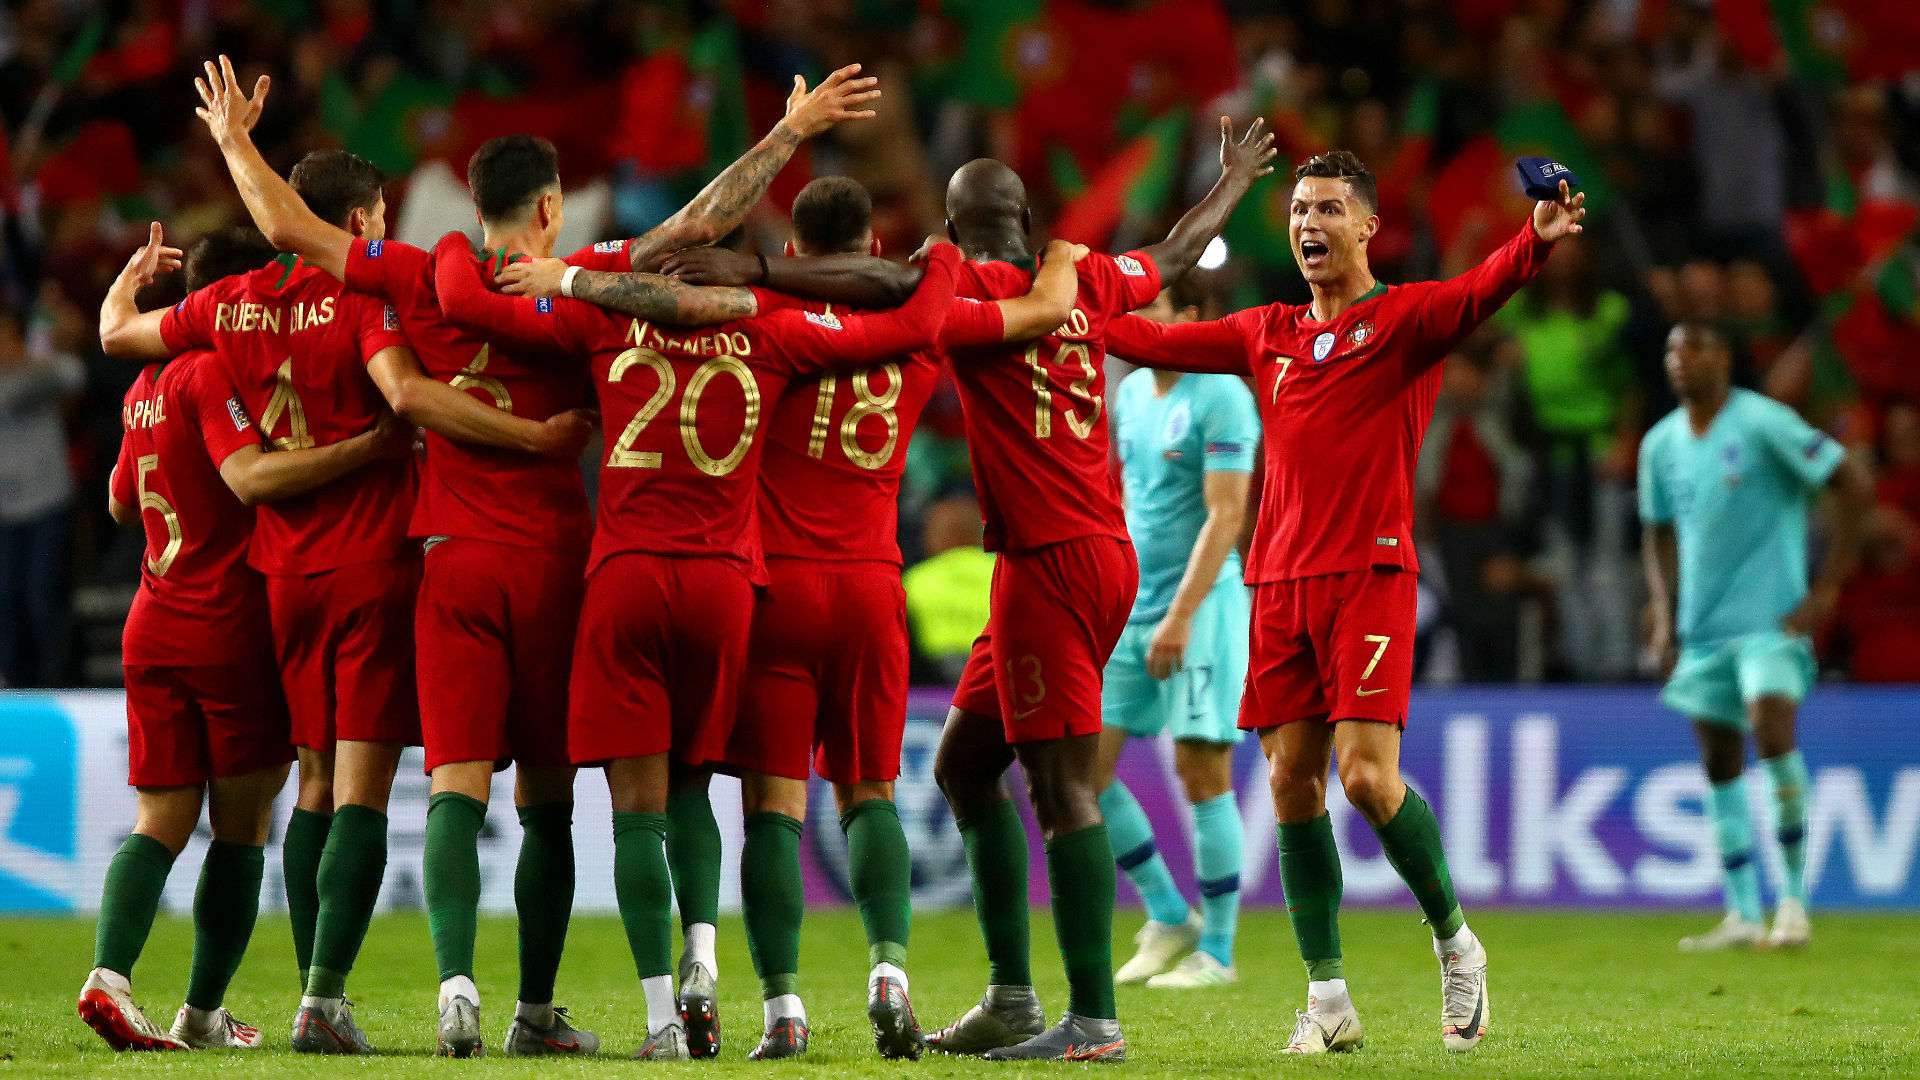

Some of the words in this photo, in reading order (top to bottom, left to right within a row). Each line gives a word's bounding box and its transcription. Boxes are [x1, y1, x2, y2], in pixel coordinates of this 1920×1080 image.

[259, 356, 315, 451] 4
[607, 348, 761, 477] 20
[807, 362, 903, 470] 18
[1025, 342, 1102, 439] 13
[1272, 356, 1294, 406] 7
[138, 453, 182, 577] 5
[1006, 653, 1046, 704] 13
[1186, 665, 1214, 706] 17
[1359, 634, 1391, 680] 7
